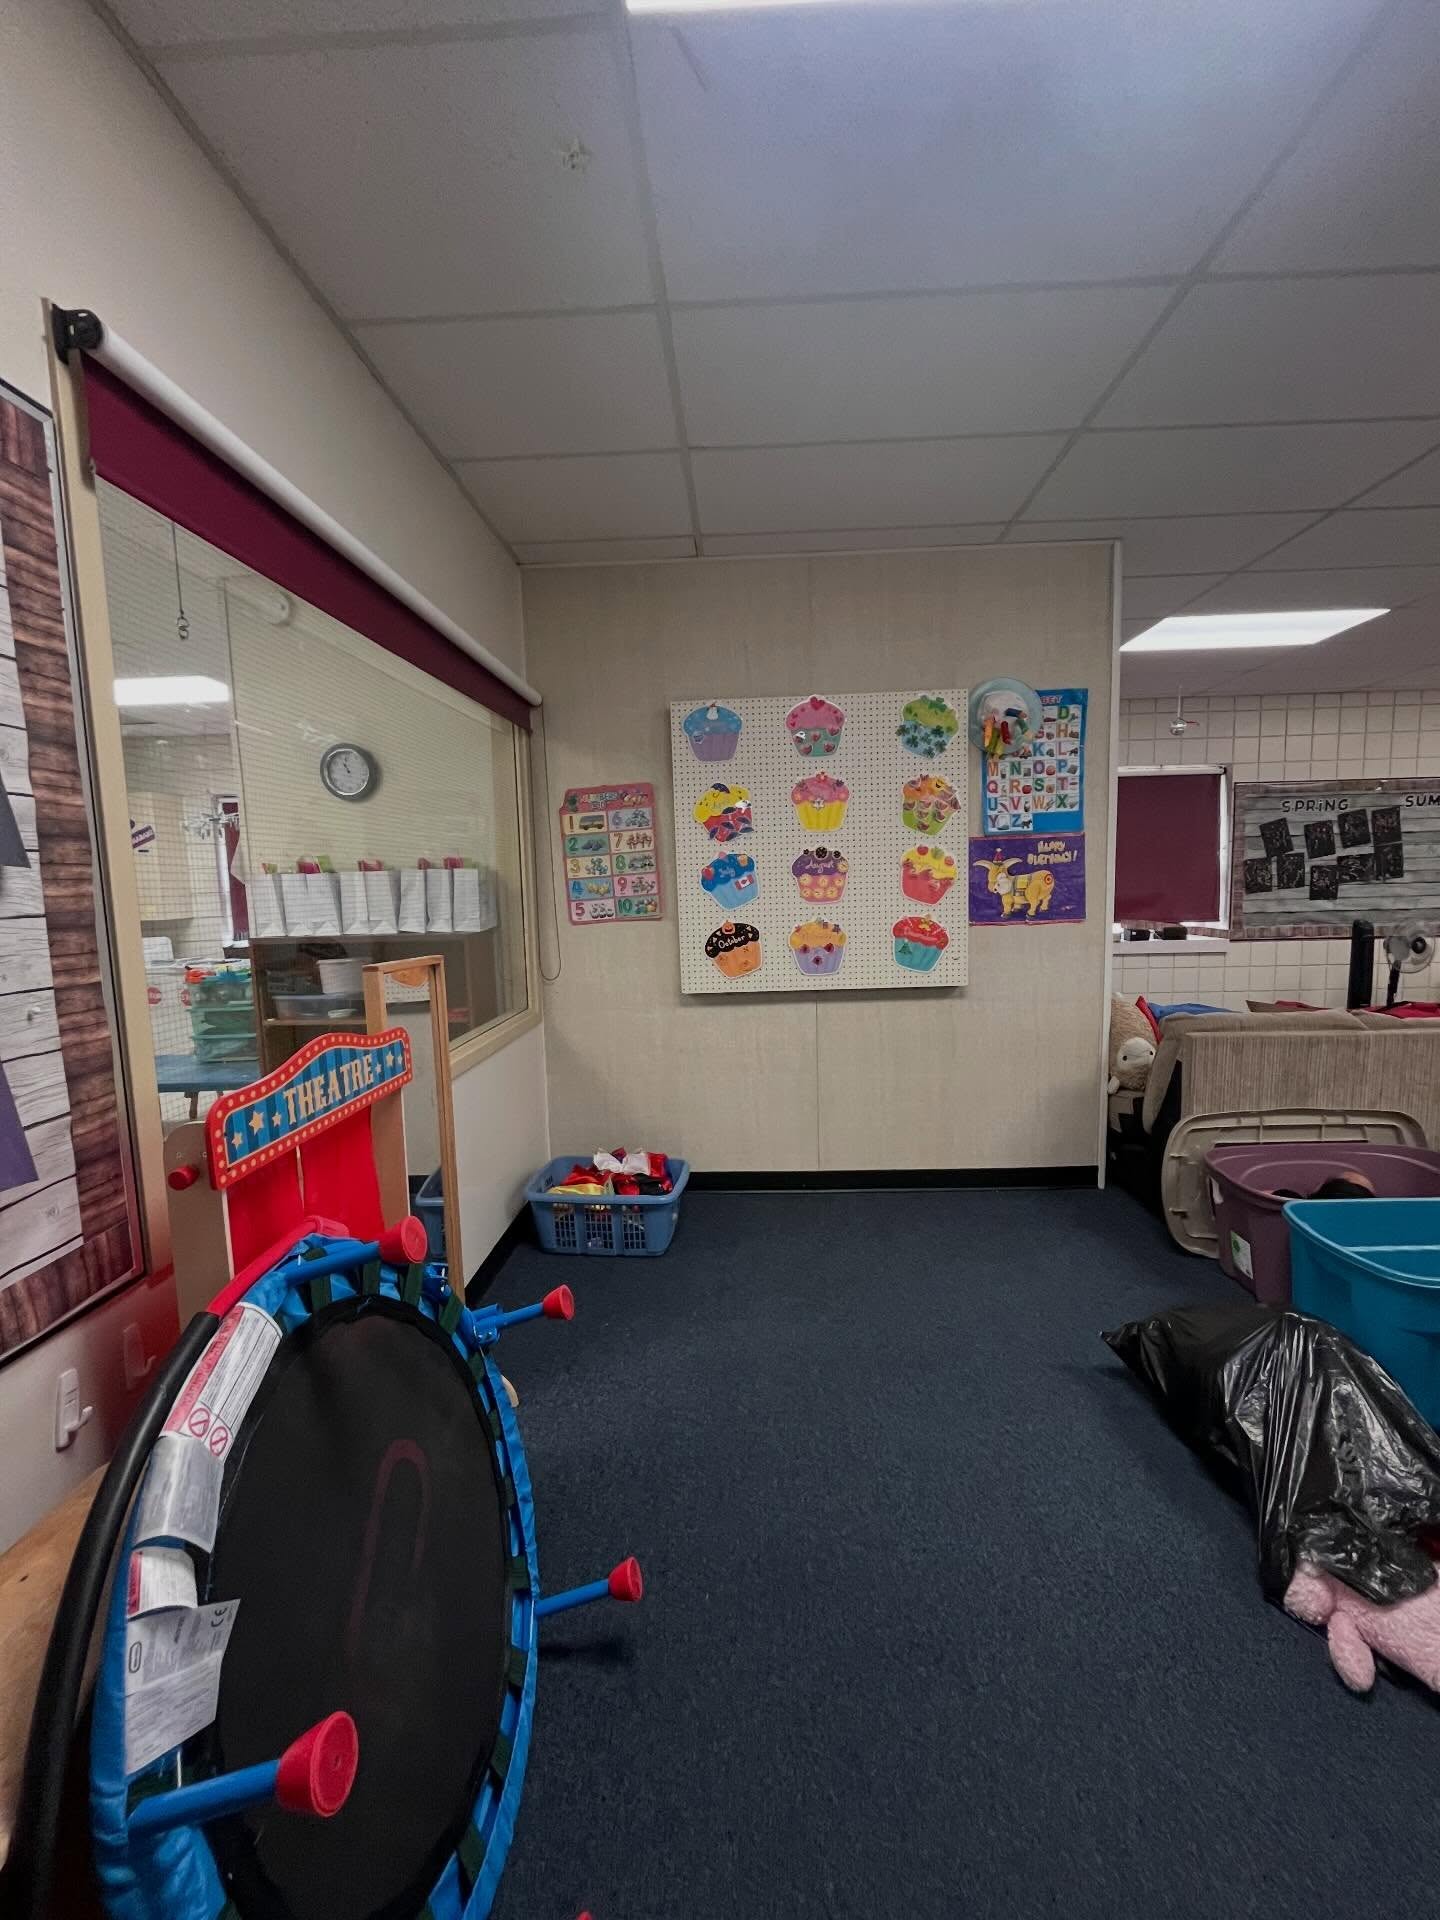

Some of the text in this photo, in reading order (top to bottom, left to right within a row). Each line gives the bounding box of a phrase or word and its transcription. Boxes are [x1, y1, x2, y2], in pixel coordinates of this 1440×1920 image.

[1058, 707, 1069, 720] D
[1057, 724, 1068, 737] H
[1033, 742, 1067, 756] K L
[988, 760, 1068, 777] M N O P
[987, 777, 1068, 794] Q R S T
[988, 794, 1068, 811] U V W X
[612, 812, 623, 826] 6
[988, 815, 1022, 829] Y Z
[568, 833, 623, 851] 2 7
[570, 855, 626, 873] 3 8
[805, 860, 835, 874] August
[572, 877, 627, 895] 4 9
[575, 899, 632, 917] 5 10
[718, 934, 746, 949] October
[283, 1054, 374, 1125] THEATRE
